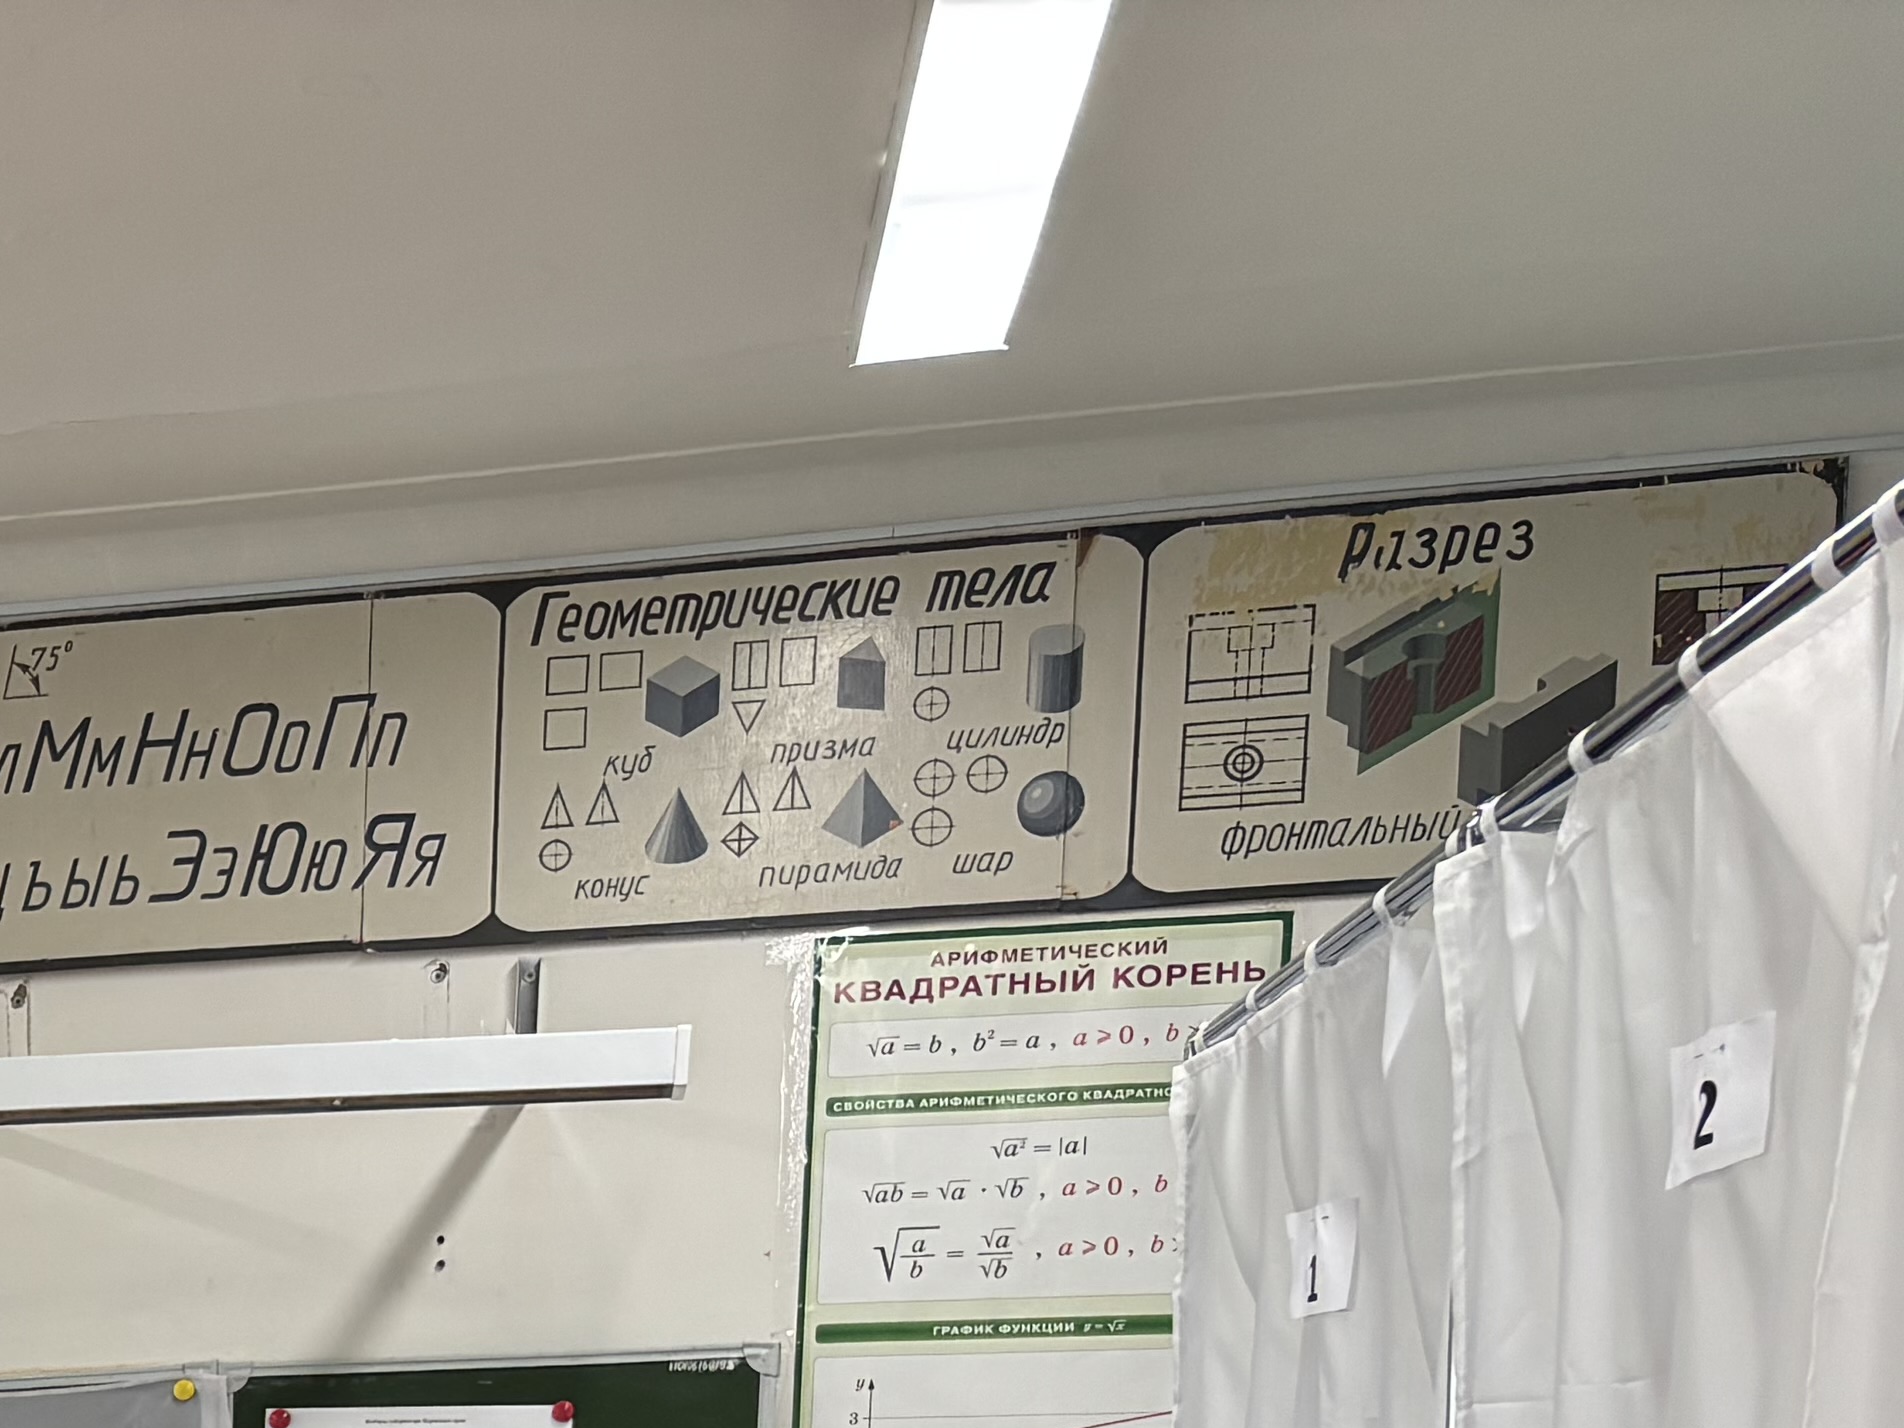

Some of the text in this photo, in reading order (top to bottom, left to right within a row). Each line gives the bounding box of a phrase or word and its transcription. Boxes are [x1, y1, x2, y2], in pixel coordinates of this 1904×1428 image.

[530, 561, 1057, 647] Геометрические тела
[771, 736, 876, 765] призма
[947, 718, 1065, 751] цилиндр
[603, 744, 656, 778] куб
[1220, 805, 1462, 861] фронтальный
[758, 855, 904, 890] пирамида
[952, 850, 1014, 876] шар
[575, 875, 651, 901] конус
[931, 937, 1168, 968] АРИФМЕТИЧЕСКИЙ
[834, 960, 1266, 1004] КВАДРАТНЫЙ КОРЕНЬ
[833, 1086, 1172, 1112] СВОЙСТВА АРИФМЕТИЧЕСКОГО КВАДРАТНО
[1693, 1080, 1718, 1150] 2
[1306, 1254, 1318, 1303] 1
[933, 1322, 1075, 1336] ГРАФИК ФУНКЦИИ
[849, 1413, 858, 1425] 3
